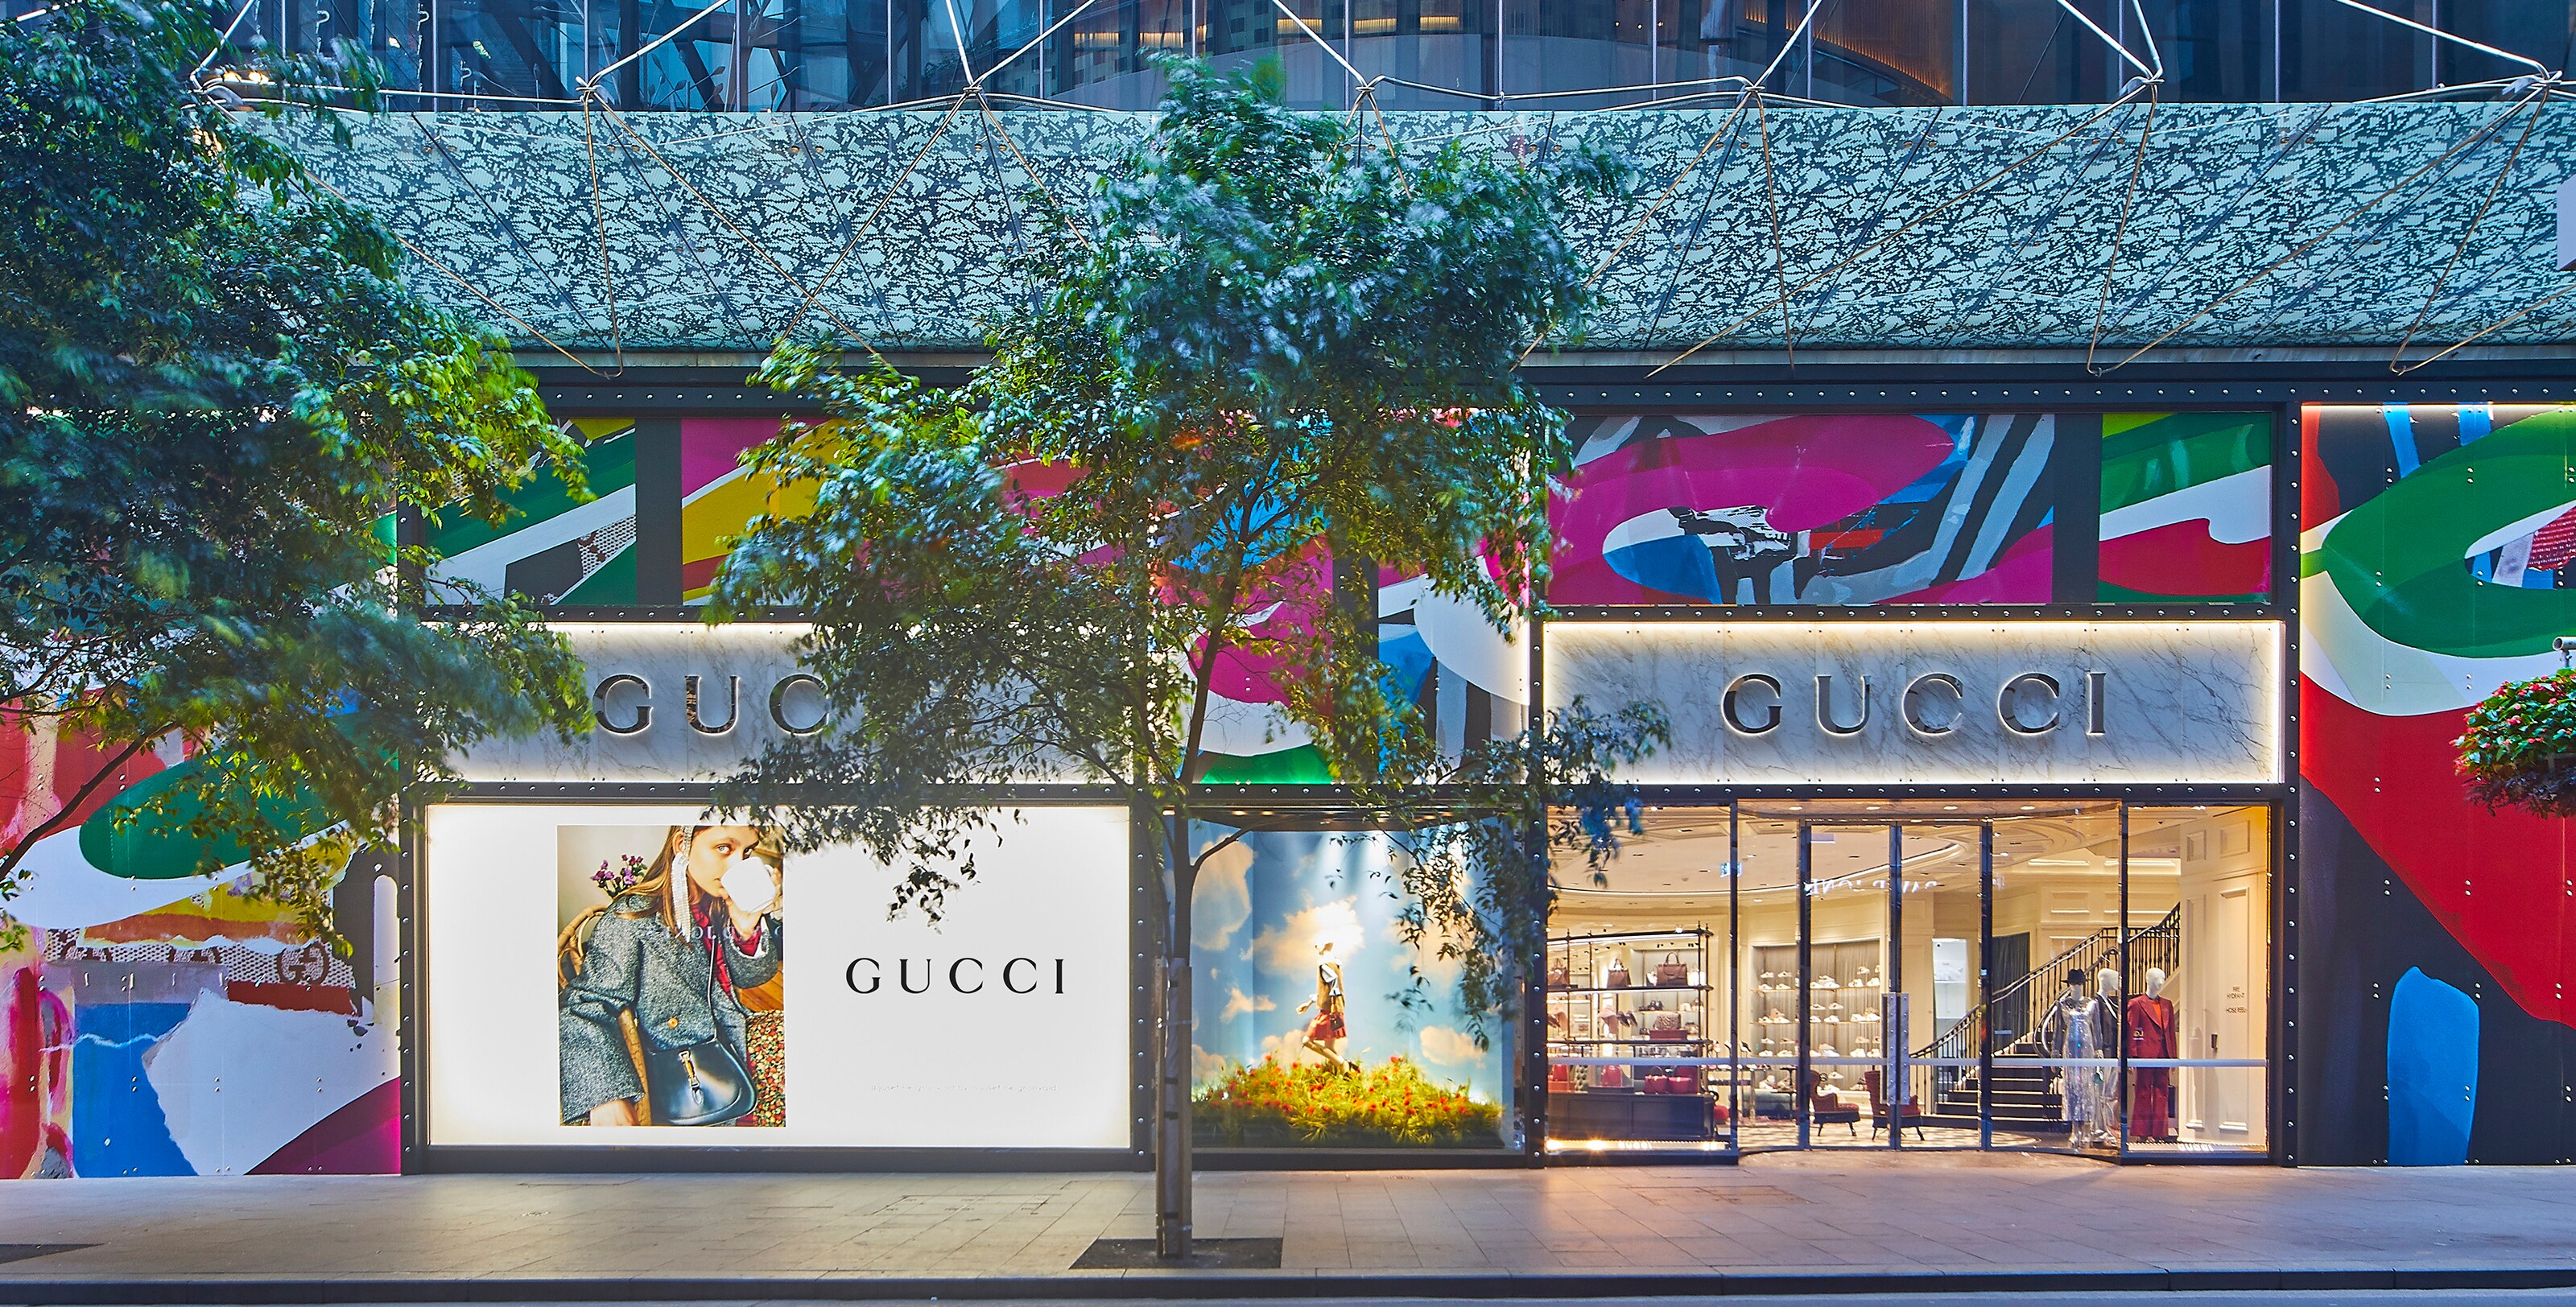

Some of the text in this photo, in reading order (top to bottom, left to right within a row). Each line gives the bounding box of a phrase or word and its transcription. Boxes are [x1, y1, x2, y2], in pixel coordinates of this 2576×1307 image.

[592, 673, 830, 736] GUC
[1722, 672, 2107, 736] GUCCI
[846, 958, 1063, 994] GUCCI
